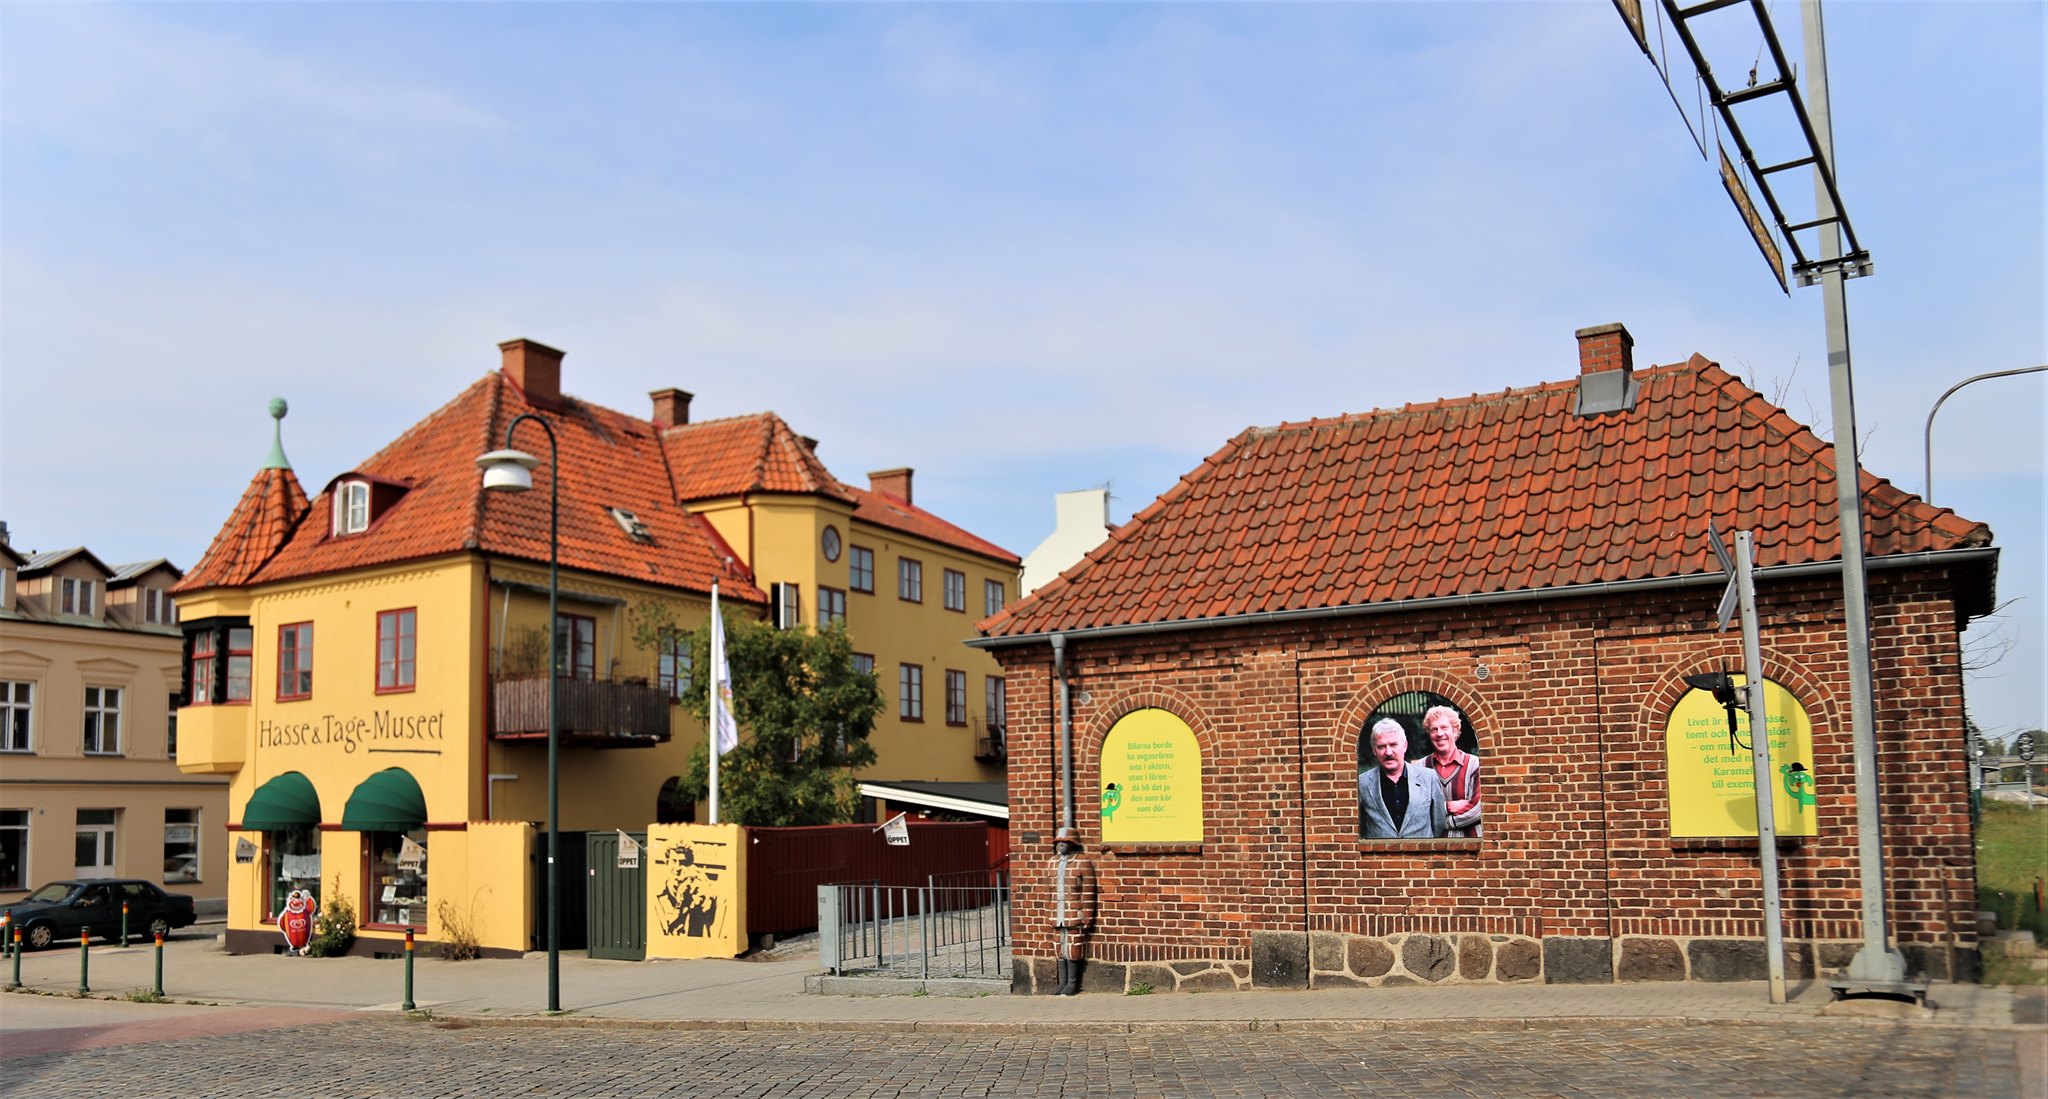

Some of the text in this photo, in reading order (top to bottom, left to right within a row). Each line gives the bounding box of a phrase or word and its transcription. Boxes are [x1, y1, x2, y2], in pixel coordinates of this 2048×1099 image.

[1688, 718, 1709, 726] Livet
[1712, 717, 1721, 725] är
[1725, 717, 1745, 725] sm
[1686, 731, 1708, 739] tomt
[1711, 729, 1727, 738] och
[1128, 740, 1173, 750] Bilarna borde
[1700, 743, 1715, 751] om
[1137, 752, 1174, 761] avgasrören
[1704, 755, 1719, 764] det
[1722, 754, 1742, 763] med
[1131, 783, 1140, 791] då
[1151, 783, 1162, 791] det
[1163, 783, 1171, 792] ju
[1712, 779, 1724, 788] till
[1160, 793, 1172, 801] kör
[887, 835, 908, 843] ÖPPET
